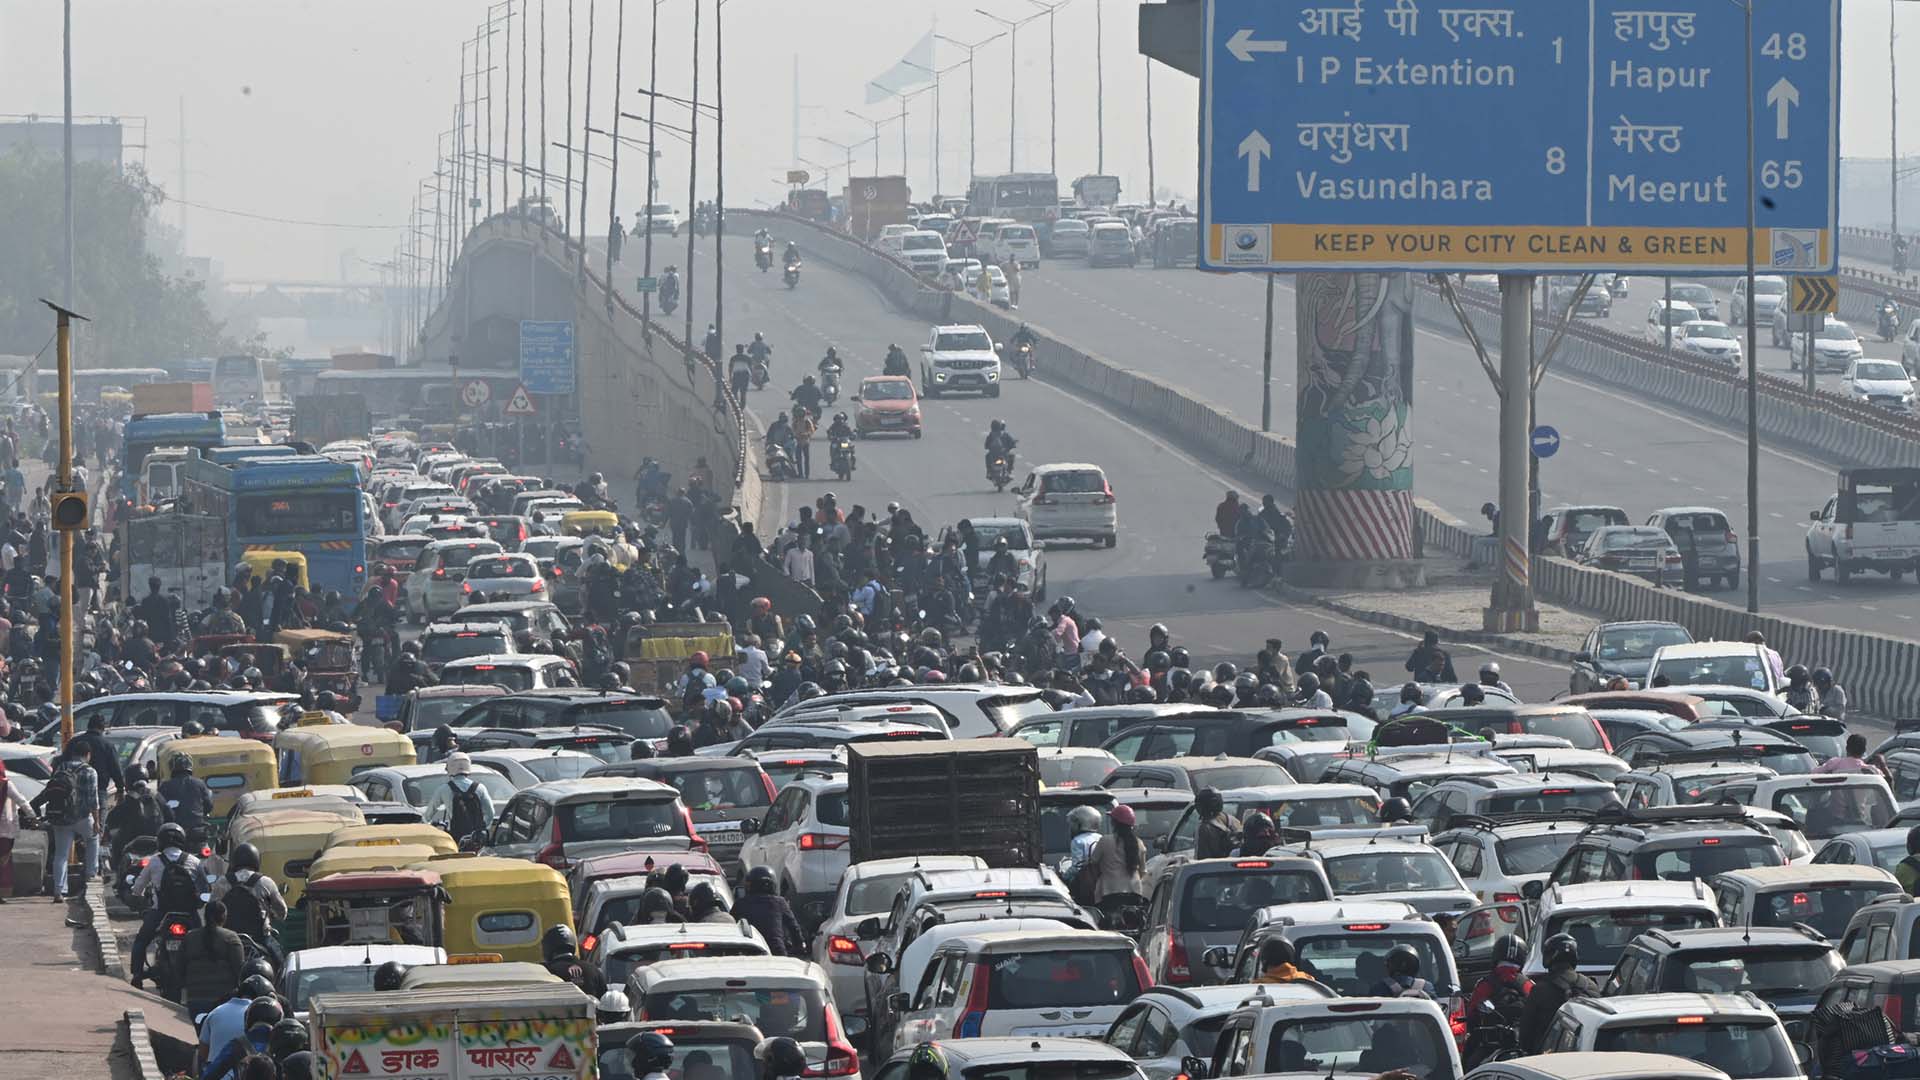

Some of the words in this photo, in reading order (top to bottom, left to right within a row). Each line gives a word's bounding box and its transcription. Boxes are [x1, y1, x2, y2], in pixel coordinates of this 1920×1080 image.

[1298, 0, 1364, 42] आई
[1384, 0, 1419, 36] पी
[1438, 8, 1524, 43] एक्स.
[1611, 11, 1697, 51] हापुड़
[1551, 36, 1562, 64] 1
[1760, 32, 1807, 60] 48
[1296, 56, 1304, 84] I
[1321, 56, 1341, 84] P
[1354, 57, 1515, 86] Extention
[1610, 60, 1711, 93] Hapur
[1297, 111, 1410, 164] वसुंधरा
[1611, 115, 1683, 153] मेरठ
[1546, 146, 1566, 175] 8
[1761, 160, 1804, 189] 65
[1296, 171, 1492, 201] Vasundhara
[1609, 174, 1727, 203] Meerut
[1314, 233, 1375, 252] KEEP
[1386, 233, 1451, 252] YOUR
[1464, 234, 1515, 253] CITY
[1528, 234, 1606, 254] CLEAN
[1618, 235, 1633, 254] &
[1644, 235, 1726, 254] GREEN
[381, 1048, 440, 1073] डाक
[466, 1039, 543, 1073] पार्सल
